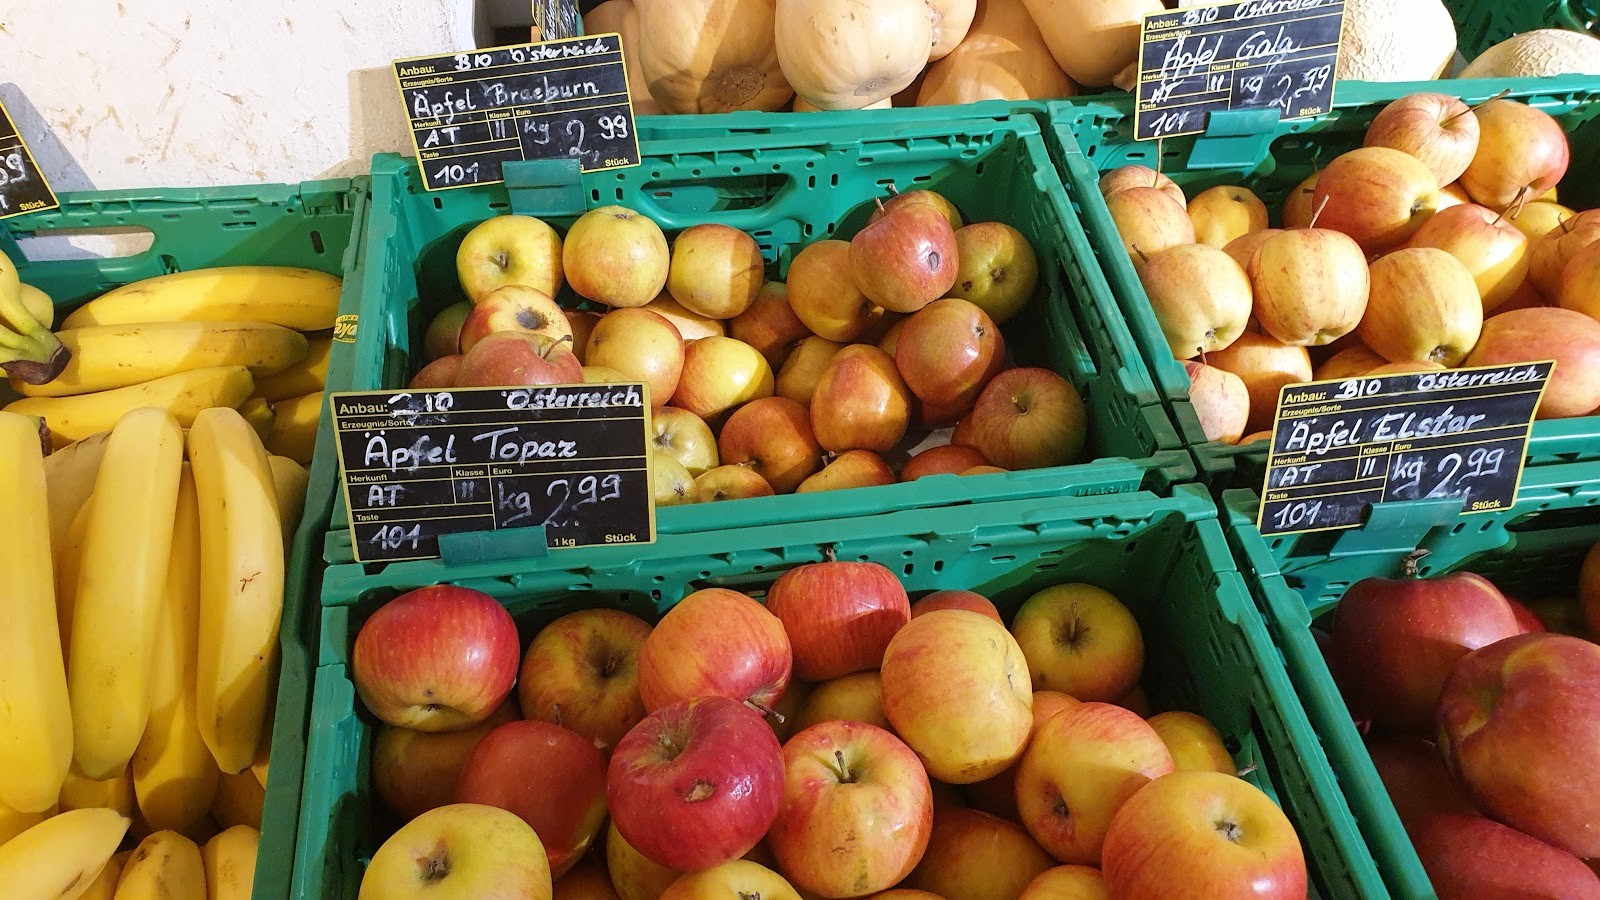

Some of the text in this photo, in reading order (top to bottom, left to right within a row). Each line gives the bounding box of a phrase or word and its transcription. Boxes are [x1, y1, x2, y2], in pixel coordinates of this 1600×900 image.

[1146, 19, 1179, 30] Anbau:
[1235, 26, 1301, 60] Gala
[400, 66, 435, 77] Anbau:
[454, 53, 493, 71] BIO
[1211, 63, 1231, 71] Klasse
[402, 76, 454, 88] Erzeugnis/Sorte
[412, 88, 477, 125] Äpfel
[1299, 106, 1322, 116] Stück
[423, 126, 461, 149] AT
[604, 157, 630, 167] Stück
[433, 161, 479, 185] 101
[19, 200, 47, 211] Stück
[1284, 365, 1544, 404] Anbau: BIO Österreich
[339, 403, 389, 415] Anbau:
[501, 384, 641, 409] Österreich
[1281, 404, 1342, 417] Erzeugnis/Sorte
[1285, 418, 1362, 456] Äpfel
[364, 426, 578, 473] Äpfel Topaz
[1363, 446, 1388, 455] Klasse
[1394, 443, 1412, 451] Euro
[1273, 455, 1307, 466] Herkunft
[455, 469, 484, 477] Klasse
[492, 467, 513, 475] Euro
[349, 474, 388, 483] Herkunft
[367, 484, 406, 507] AT
[498, 480, 532, 527] kg
[1471, 499, 1501, 511] Stück
[356, 514, 379, 522] Taste
[1273, 500, 1323, 530] 101
[561, 537, 576, 550] kg
[604, 533, 637, 543] Stück
